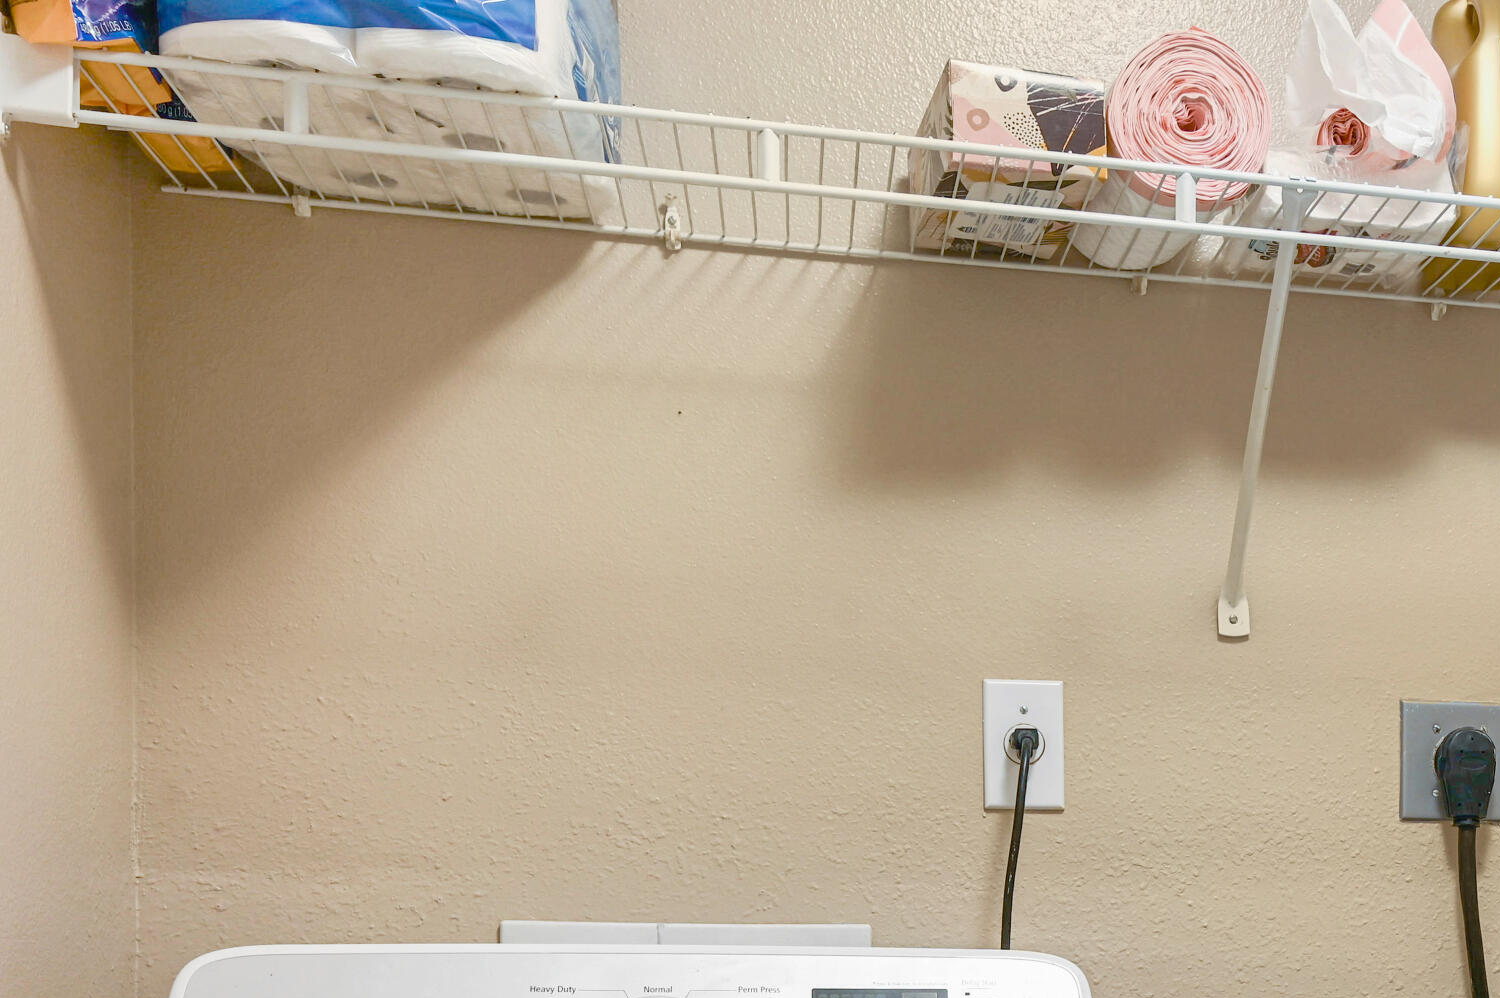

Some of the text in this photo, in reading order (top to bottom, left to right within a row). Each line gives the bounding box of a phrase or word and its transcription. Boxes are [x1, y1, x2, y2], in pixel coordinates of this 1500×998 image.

[529, 985, 577, 994] Heavy Duty
[738, 985, 781, 993] Perm Press
